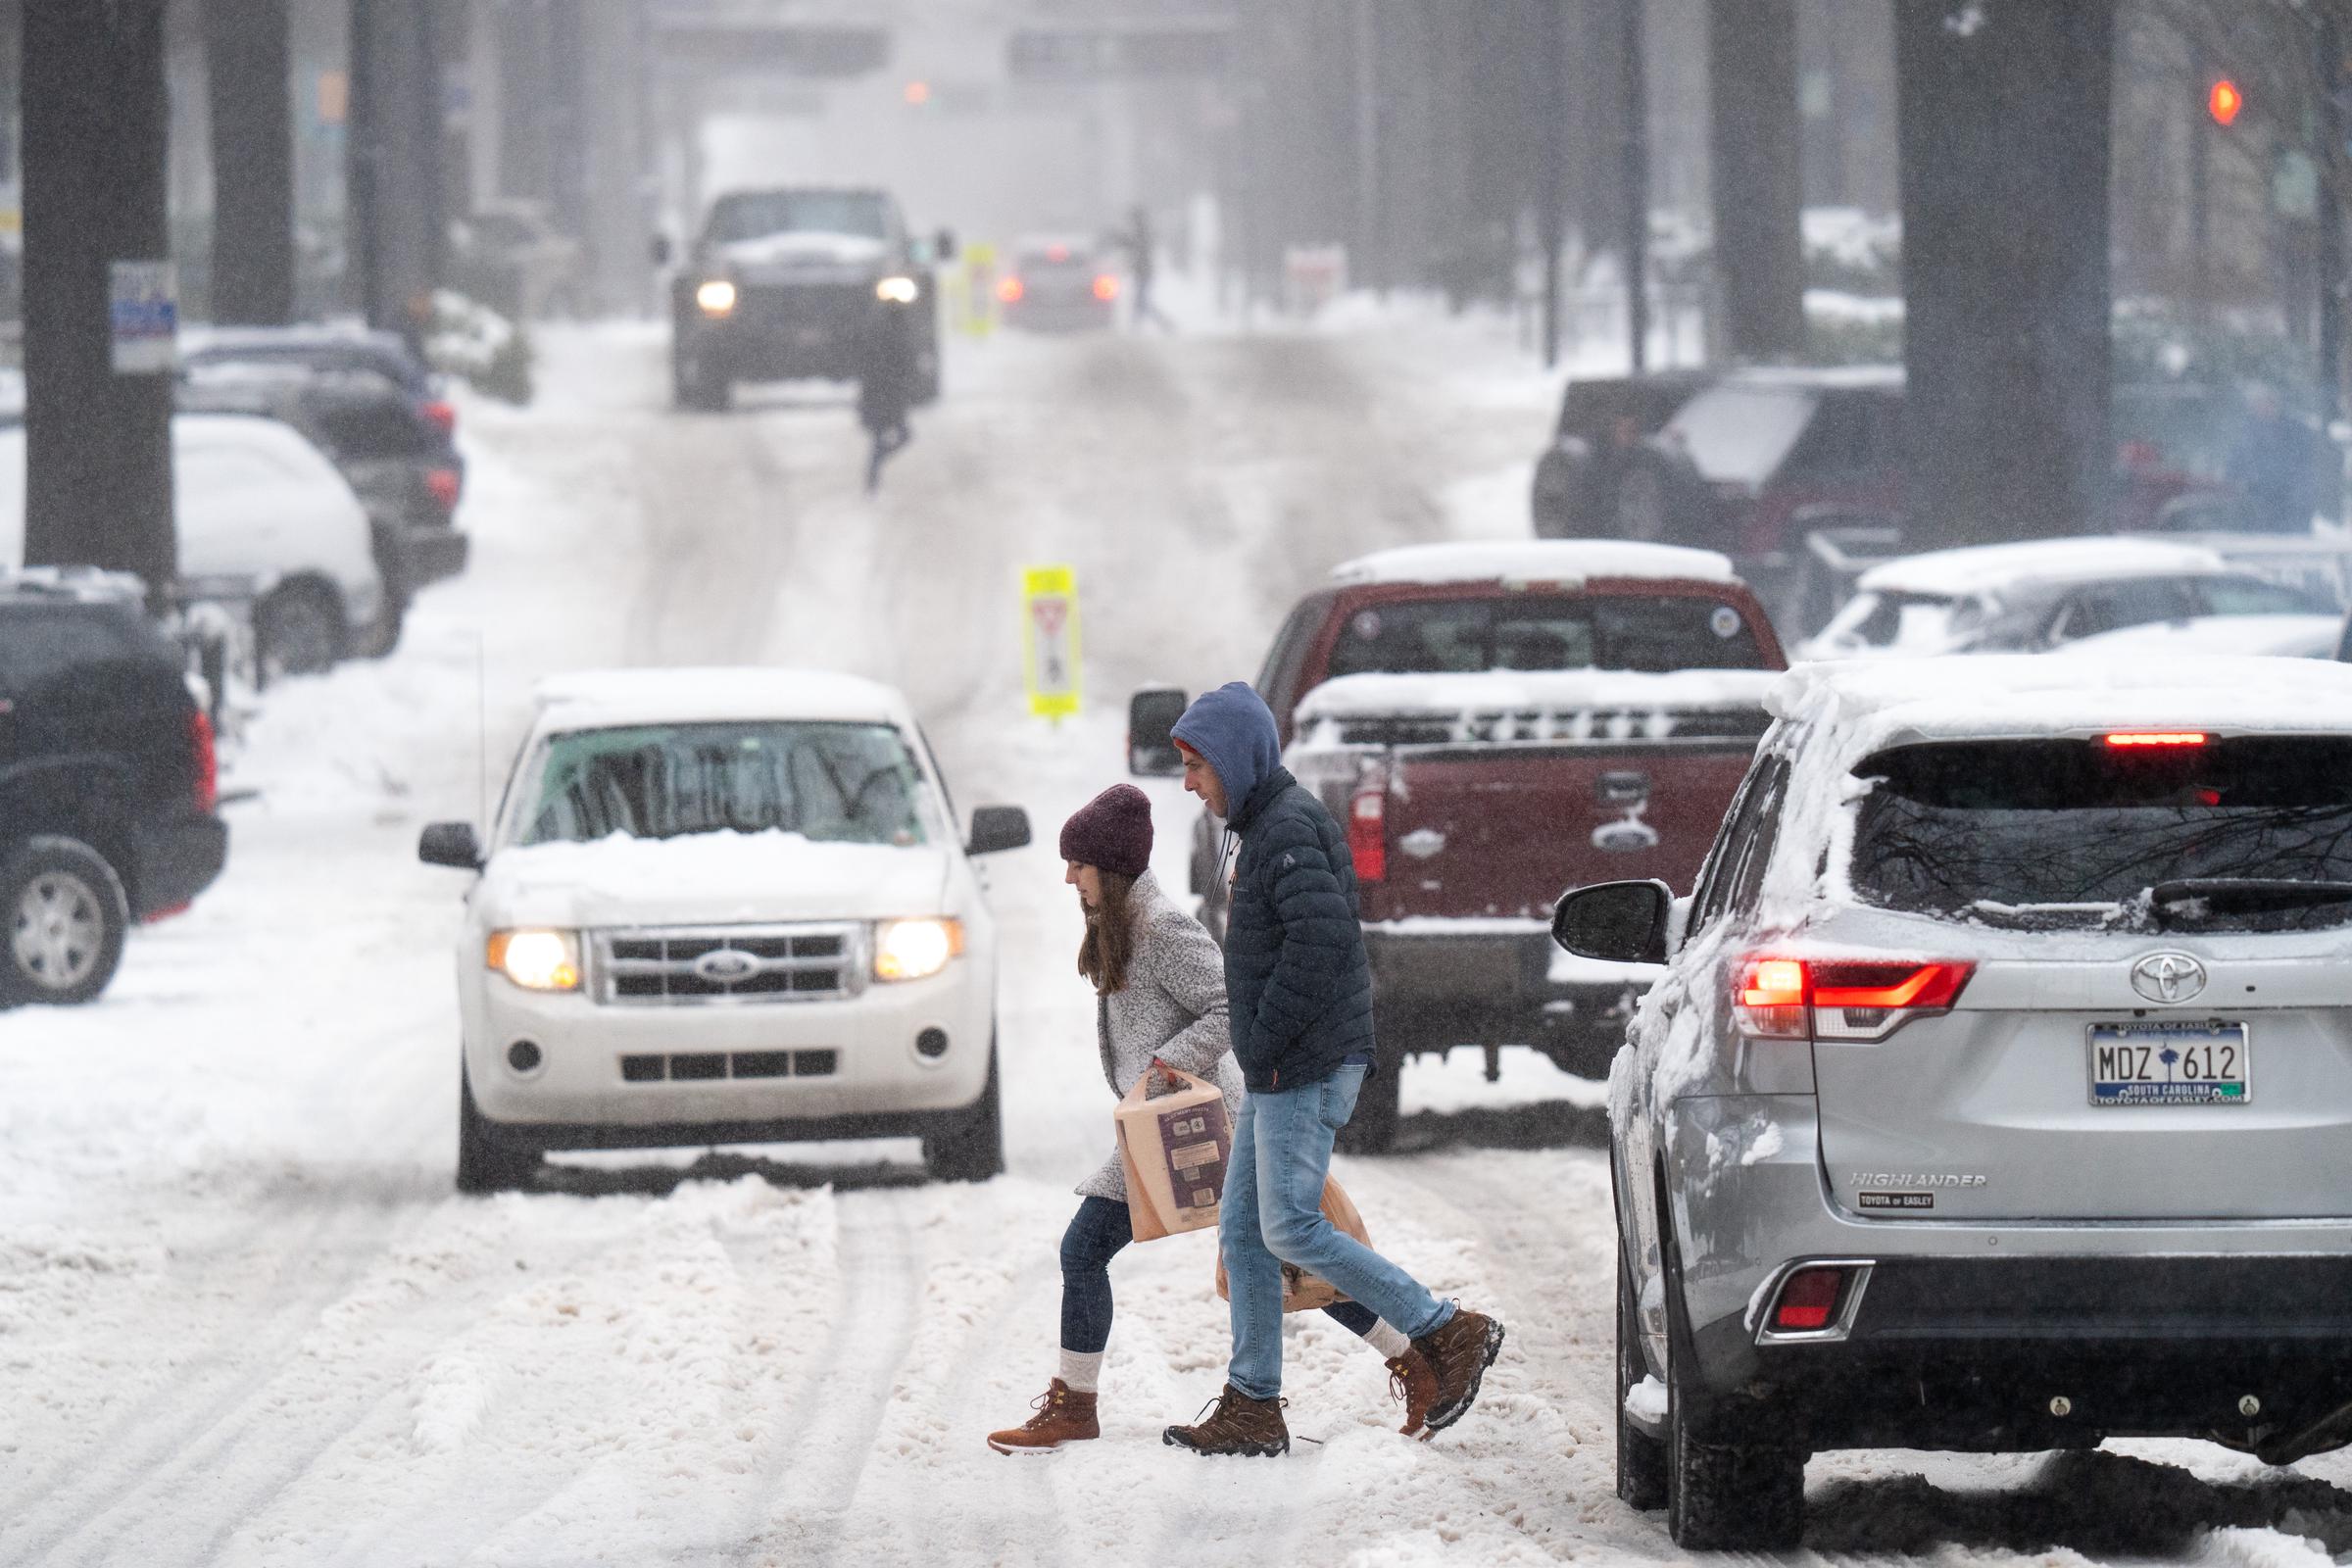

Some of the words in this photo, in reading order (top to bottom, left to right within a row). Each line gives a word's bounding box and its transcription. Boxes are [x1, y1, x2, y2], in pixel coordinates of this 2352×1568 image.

[2118, 1022, 2161, 1031] TOYOTA
[2099, 1047, 2152, 1081] MDZ
[2183, 1046, 2236, 1080] 612
[2127, 1084, 2159, 1096] SOUTH
[2162, 1084, 2211, 1096] CAROLINA
[1849, 1172, 1987, 1187] HIGHLANDER
[1861, 1196, 1891, 1205] TOYOTA
[1903, 1196, 1933, 1205] EASLEY
